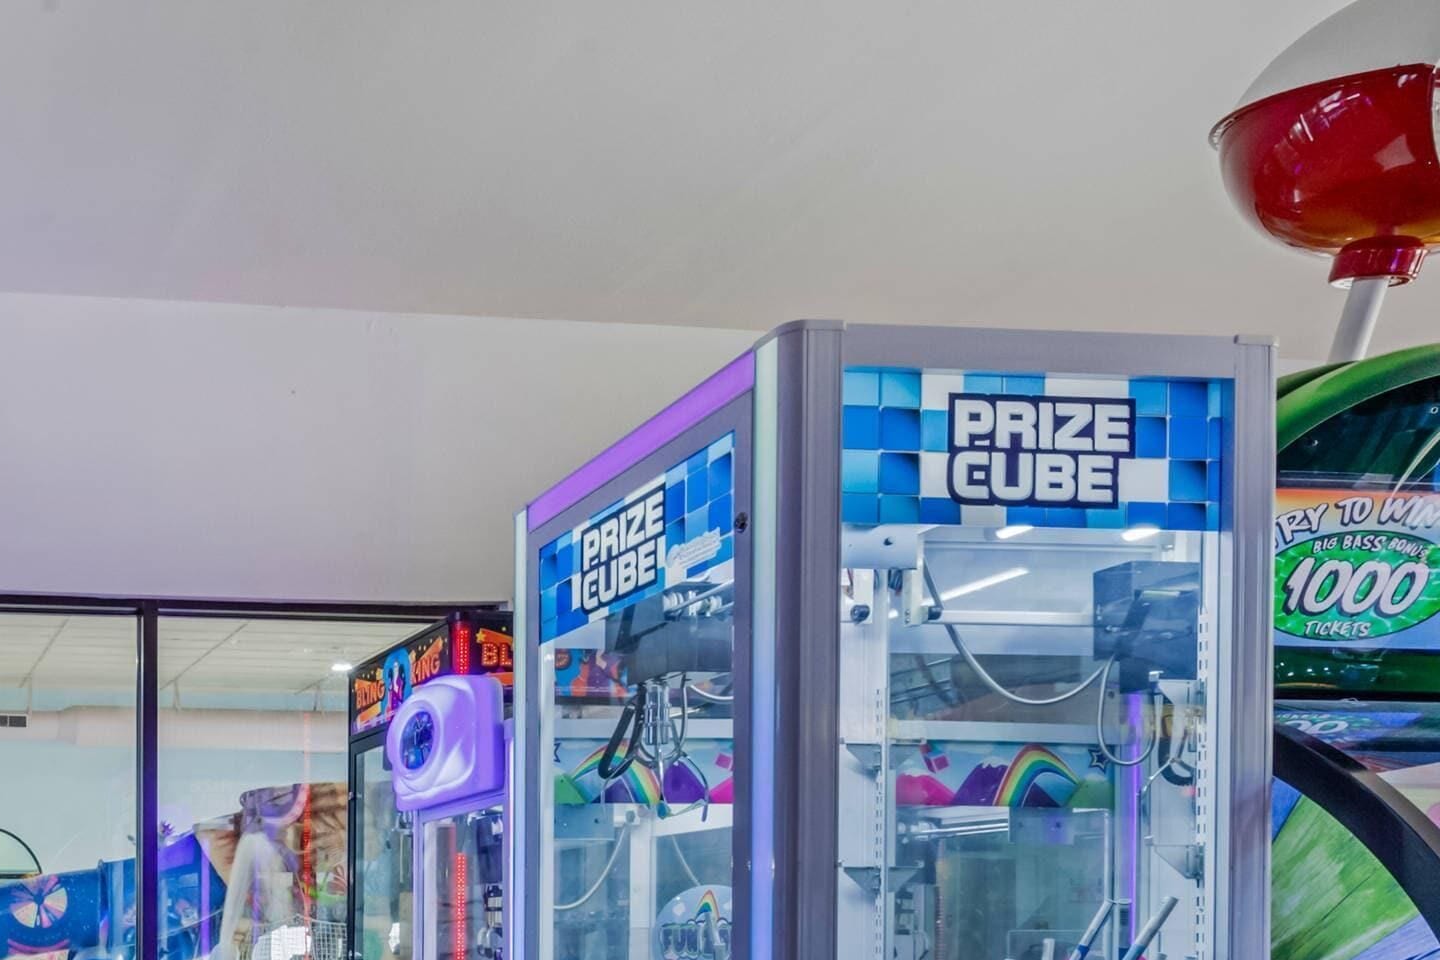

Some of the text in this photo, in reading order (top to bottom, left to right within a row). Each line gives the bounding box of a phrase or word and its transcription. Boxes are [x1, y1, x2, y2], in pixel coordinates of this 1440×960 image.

[954, 400, 1130, 451] PRIZE
[953, 453, 1113, 501] CUBE
[583, 490, 664, 572] PRIZE
[1275, 503, 1328, 548] RY
[1336, 497, 1373, 526] TO
[1313, 537, 1338, 554] BIG
[1343, 534, 1385, 552] BASS
[583, 539, 656, 611] CUBE
[1286, 556, 1429, 616] 1000
[1305, 620, 1372, 637] TICKETS
